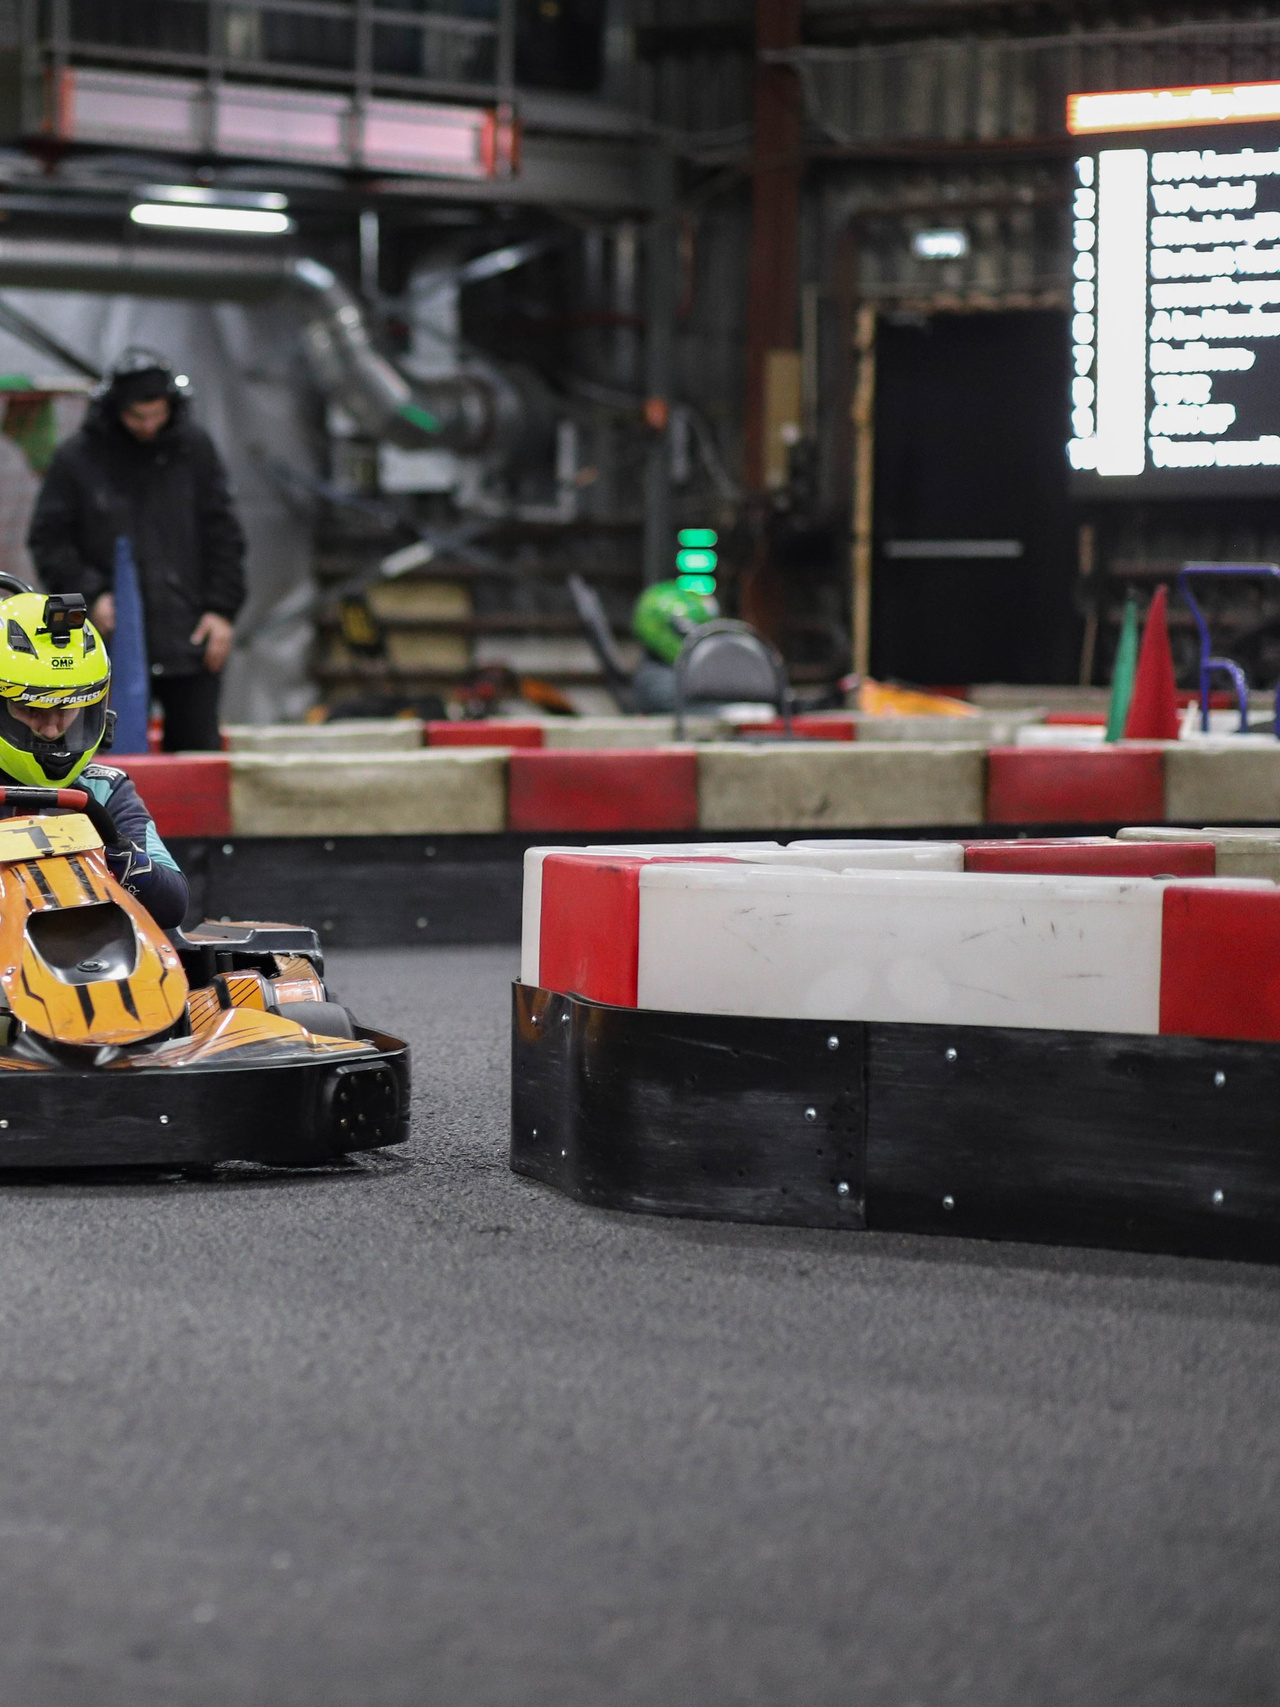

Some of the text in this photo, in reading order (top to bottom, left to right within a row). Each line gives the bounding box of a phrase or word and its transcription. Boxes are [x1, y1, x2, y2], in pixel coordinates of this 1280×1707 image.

[51, 659, 73, 667] OMP
[21, 690, 100, 704] BE THE FASTEST
